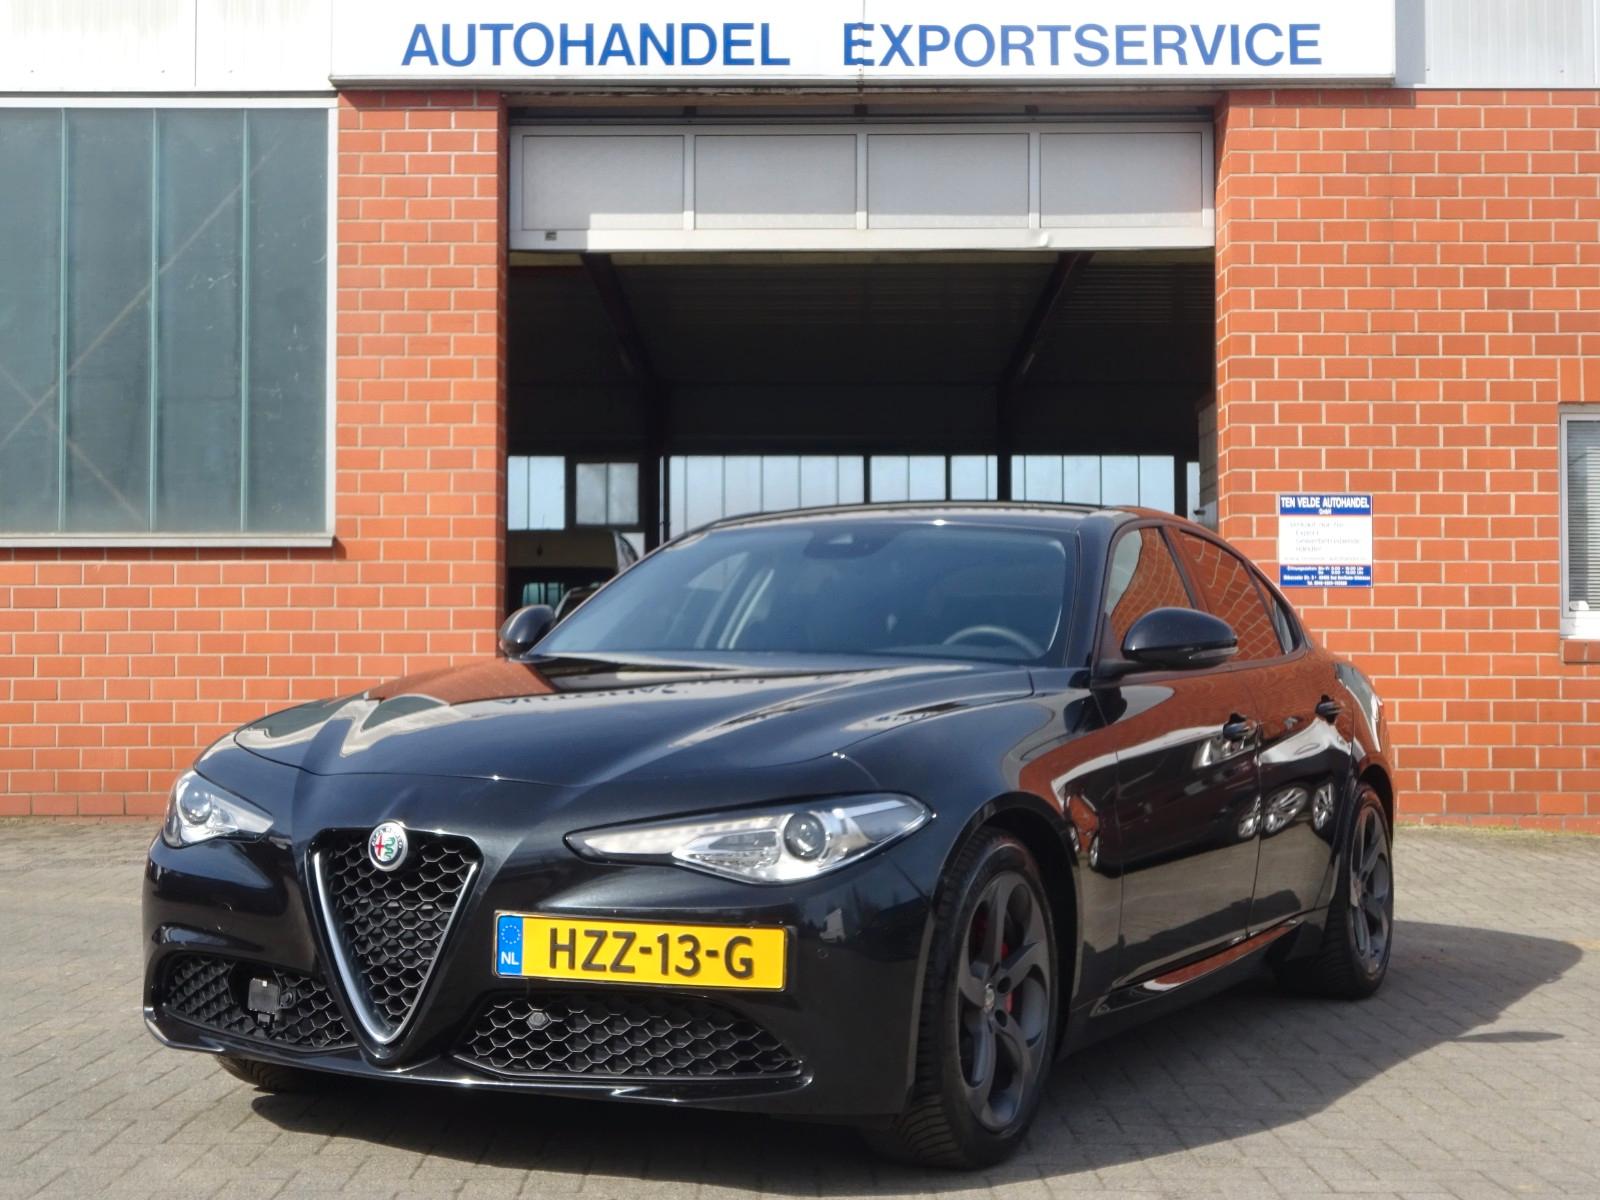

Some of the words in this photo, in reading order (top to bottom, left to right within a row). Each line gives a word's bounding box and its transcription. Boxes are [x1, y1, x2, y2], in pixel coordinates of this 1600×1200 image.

[403, 22, 790, 67] AUTOHANDEL
[844, 23, 1320, 67] EXPORTSERVICE
[1281, 496, 1295, 508] TEN
[1297, 496, 1321, 508] VELDE
[1322, 496, 1370, 508] AUTOHANDEL
[501, 951, 519, 966] NL
[549, 928, 754, 979] HZZ-13-G
